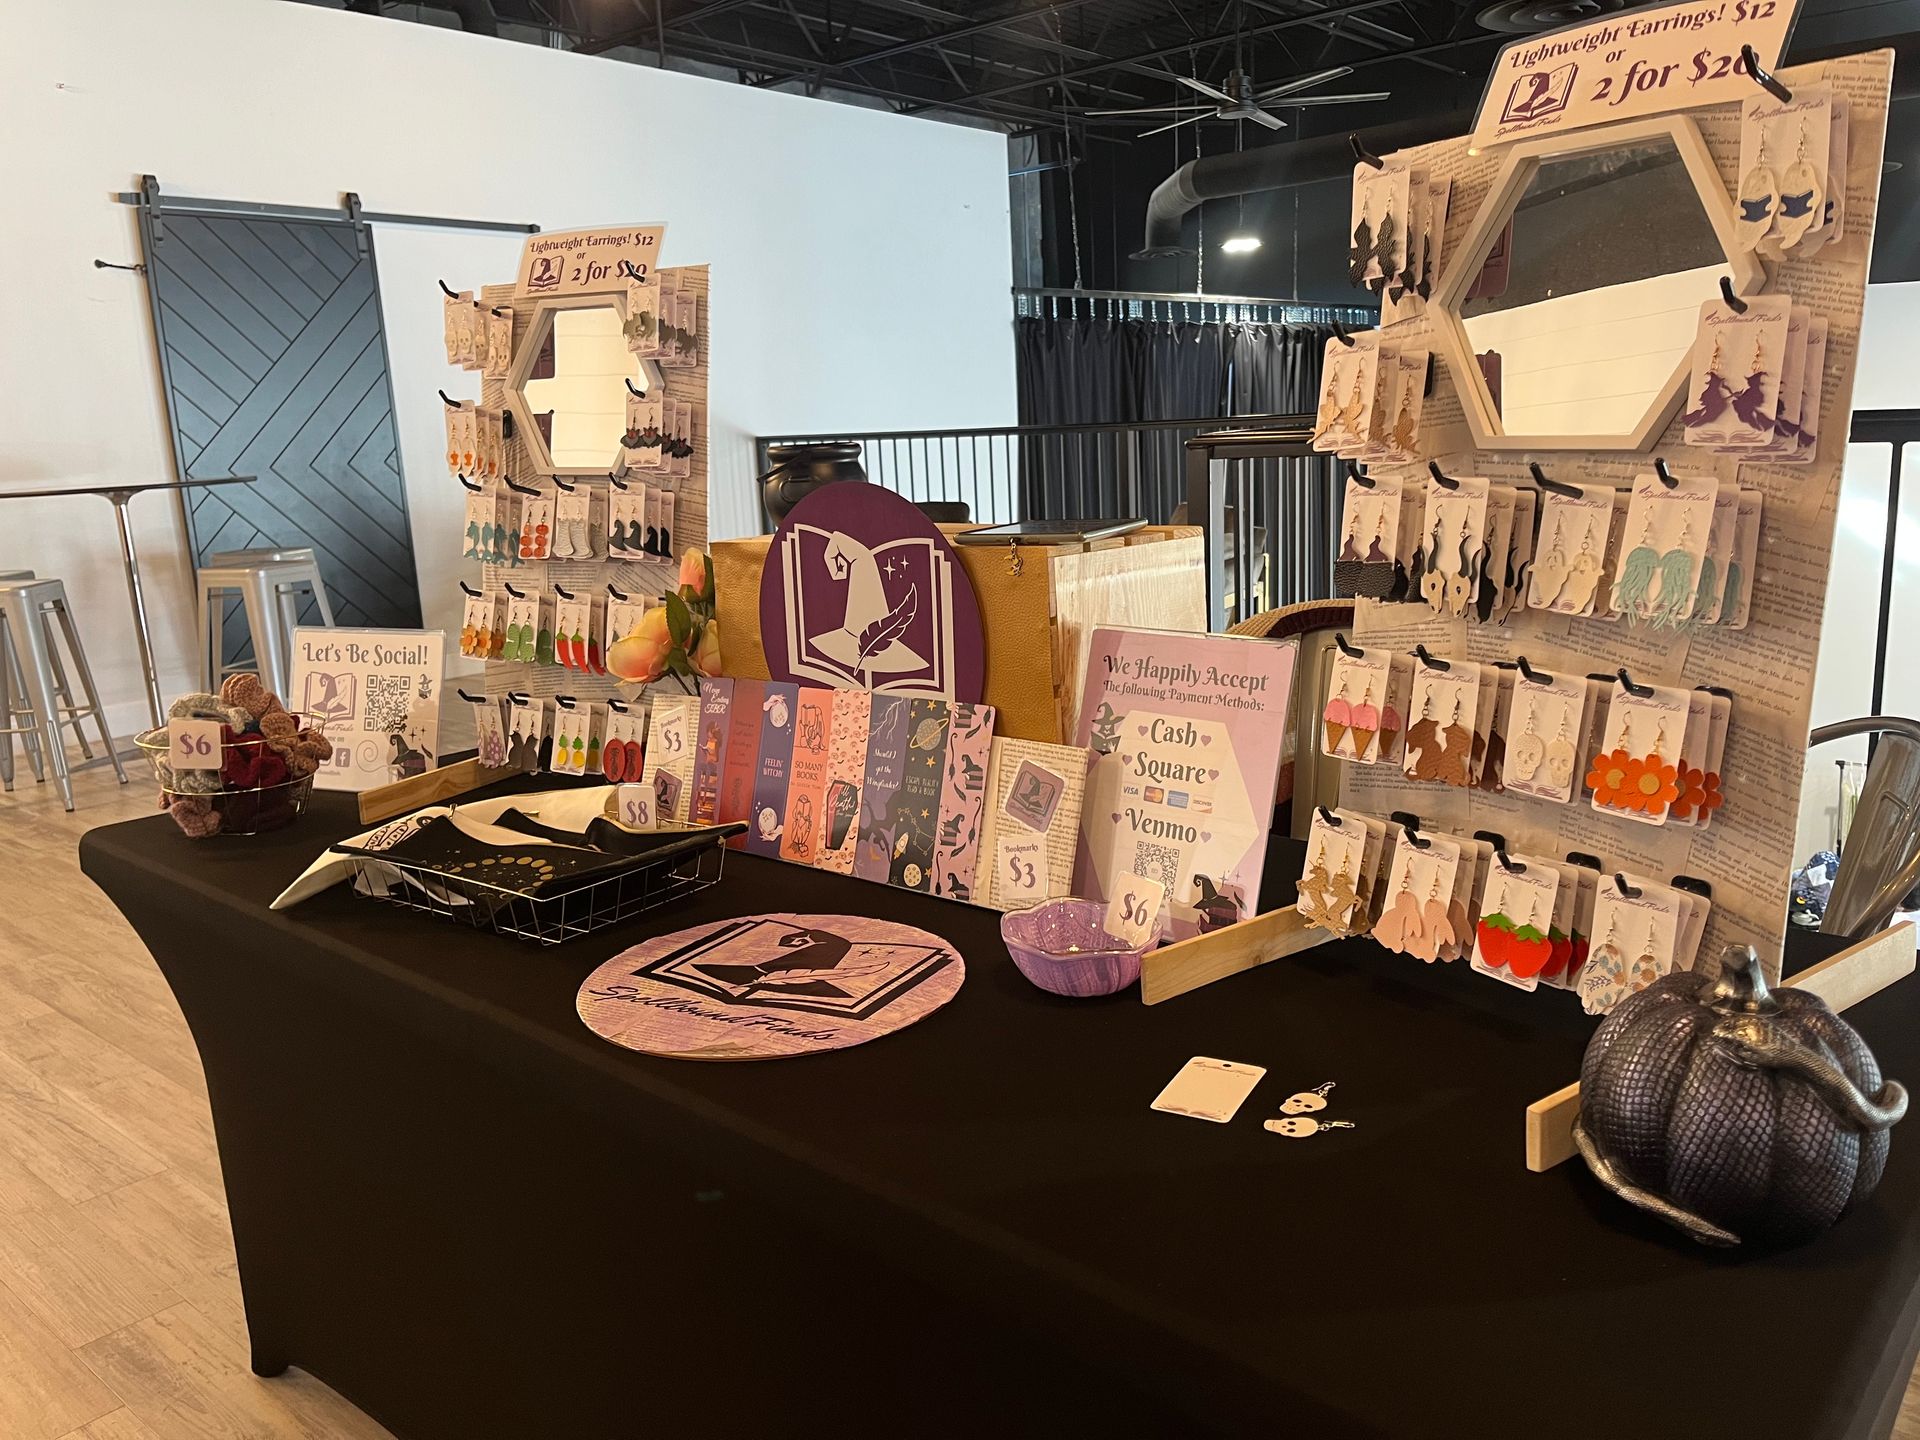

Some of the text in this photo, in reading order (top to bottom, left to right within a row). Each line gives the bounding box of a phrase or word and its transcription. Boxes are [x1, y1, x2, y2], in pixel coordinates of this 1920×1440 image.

[1510, 0, 1776, 69] Lightweight Earrings! $12
[1605, 49, 1627, 64] or
[1590, 78, 1611, 102] 2
[1609, 60, 1680, 107] for
[530, 233, 654, 255] Lightweight Earrings! $12
[576, 251, 586, 261] or
[571, 267, 581, 282] 2
[580, 260, 612, 286] for
[302, 642, 429, 667] Let's Be Social!
[1103, 654, 1269, 695] We Happily Accept
[1103, 679, 1121, 693] The
[1168, 688, 1213, 705] Payment
[1214, 694, 1265, 712] Methods:
[179, 731, 212, 759] $6
[664, 729, 683, 753] $3
[1150, 718, 1198, 748] Cash
[794, 760, 824, 771] SO MANY
[1134, 751, 1207, 784] Square
[1123, 786, 1139, 797] VISA
[626, 798, 649, 827] $8
[1125, 807, 1198, 844] Venmo
[1003, 843, 1039, 853] Bookmarks
[1009, 854, 1036, 889] $3
[1119, 890, 1149, 927] $6
[588, 985, 841, 1041] Spellbound Finds
